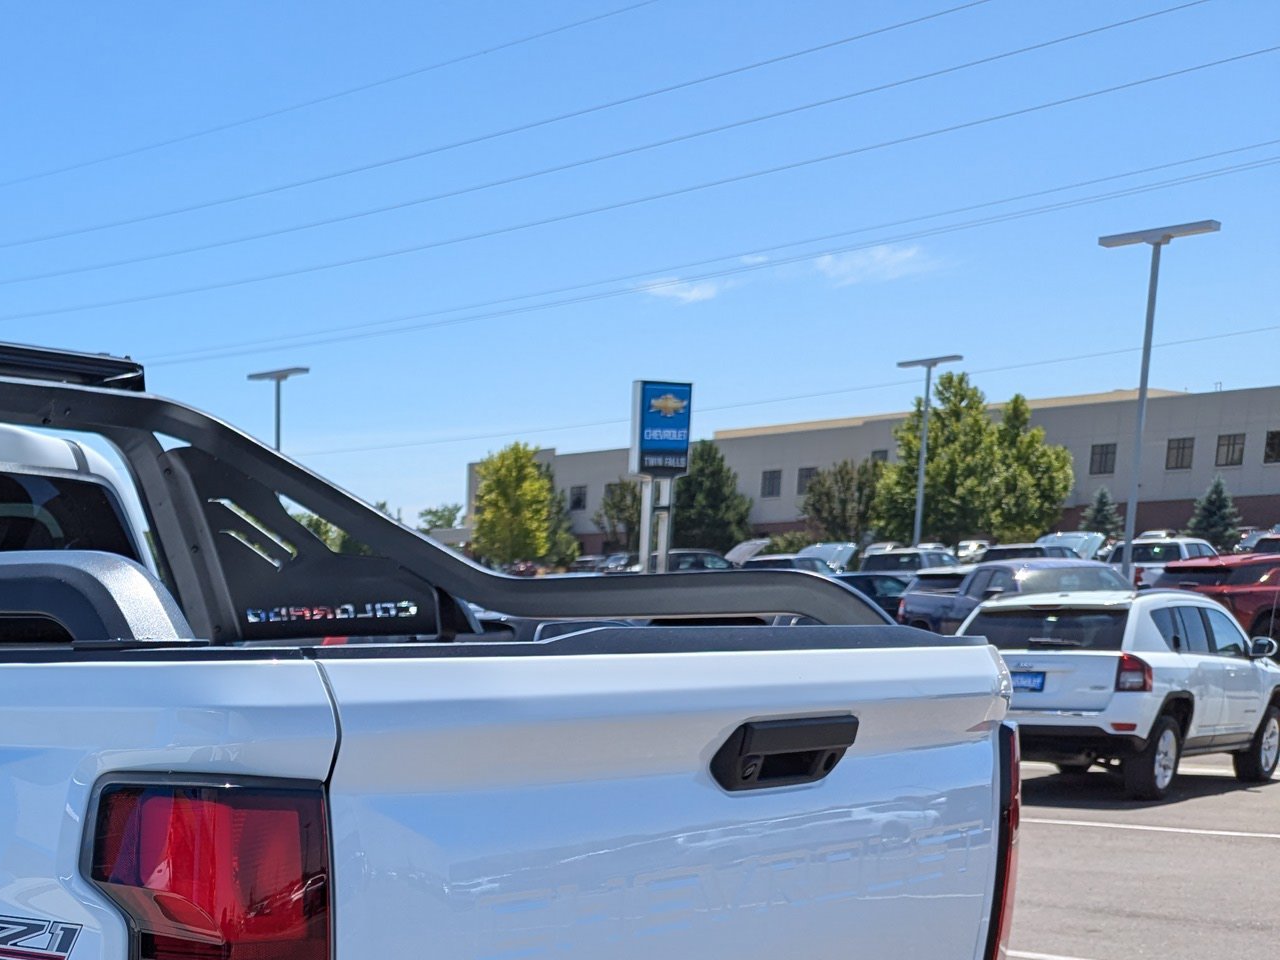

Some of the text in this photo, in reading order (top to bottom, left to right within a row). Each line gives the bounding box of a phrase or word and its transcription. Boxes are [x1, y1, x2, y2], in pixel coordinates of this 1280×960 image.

[644, 429, 687, 440] CHEVROLET
[644, 456, 686, 467] TWIN FALLS
